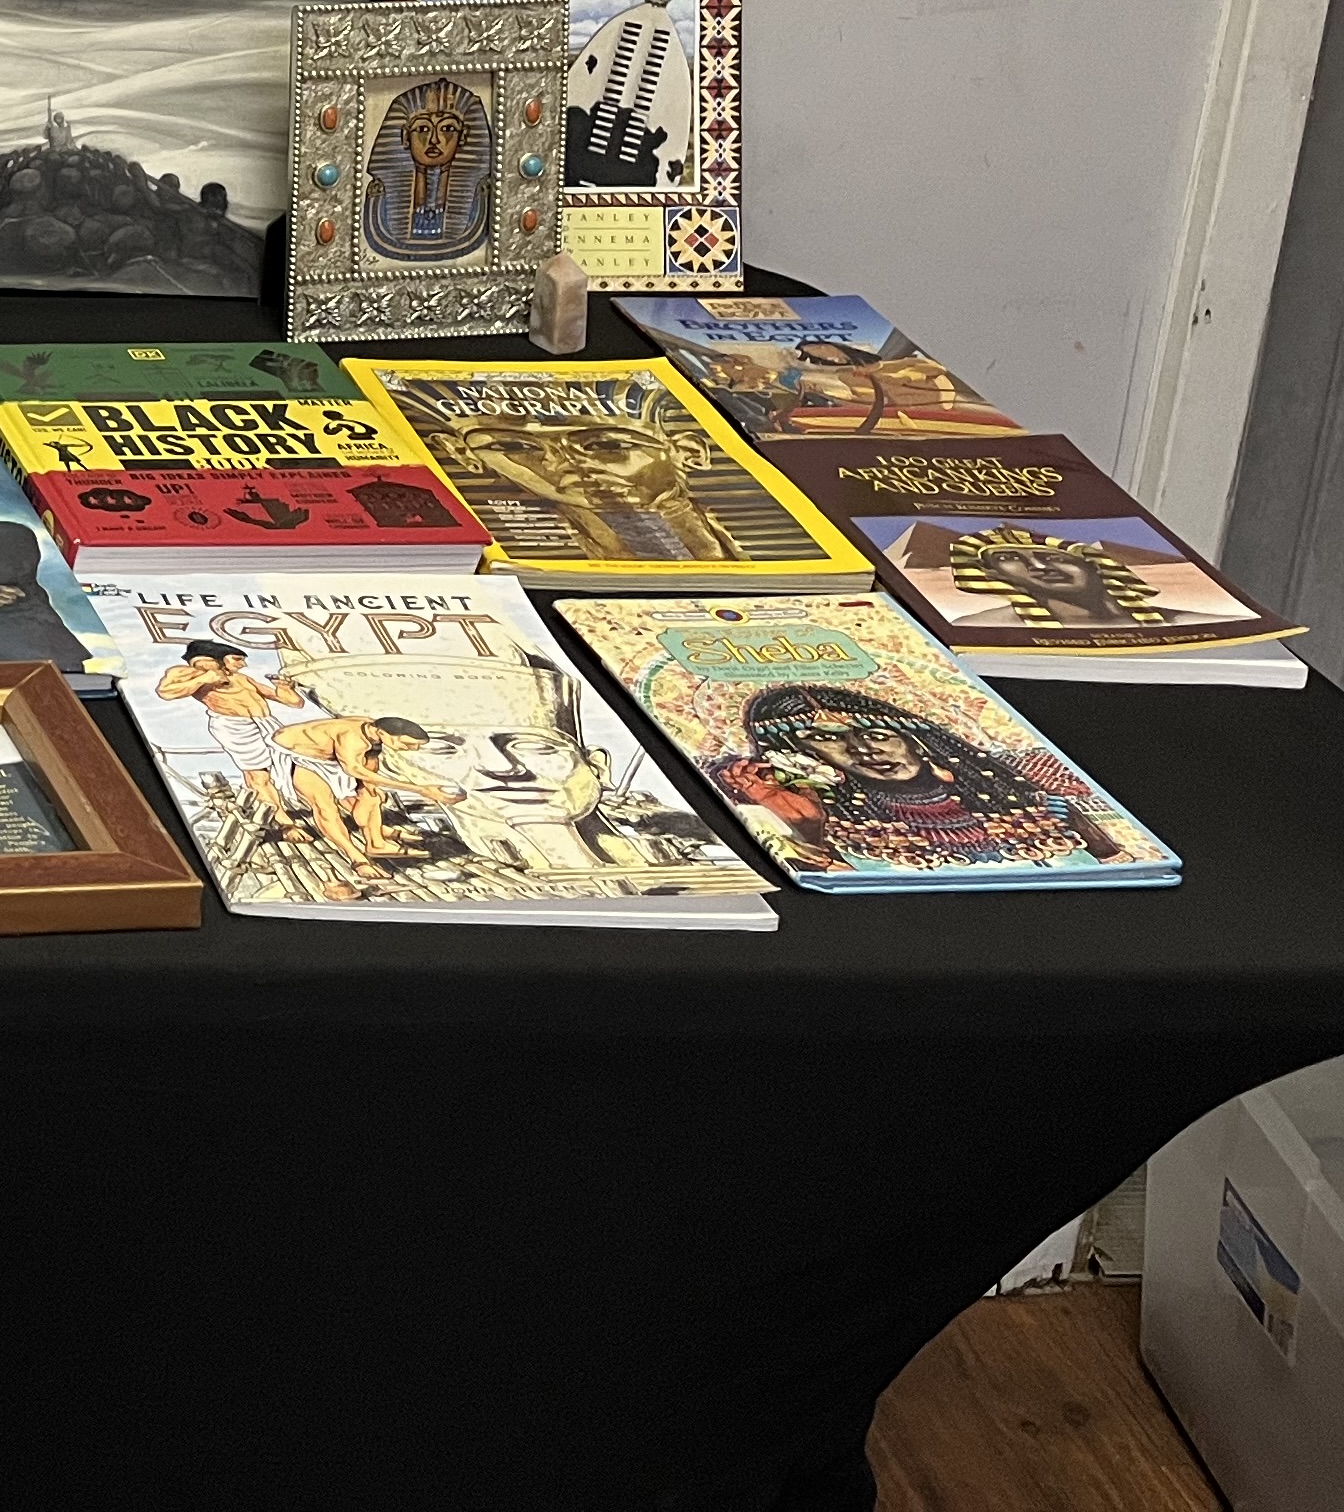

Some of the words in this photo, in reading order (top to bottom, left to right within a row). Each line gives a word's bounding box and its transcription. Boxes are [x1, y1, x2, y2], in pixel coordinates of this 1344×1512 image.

[676, 319, 859, 332] BROTHERS
[705, 332, 738, 341] IN
[742, 331, 855, 343] EGYPT
[132, 349, 161, 360] DK
[456, 385, 607, 400] NATIONAL
[81, 403, 313, 433] BLACK
[296, 399, 354, 407] MATTER
[435, 399, 643, 417] GEOGRAPHIC
[102, 432, 323, 457] HISTORY
[191, 457, 269, 471] BOOK
[337, 442, 388, 451] AFRICA
[344, 454, 401, 462] HUMANITY
[875, 455, 929, 467] 100
[931, 455, 1004, 470] GREAT
[129, 472, 157, 481] BIG
[160, 472, 206, 481] IDEAS
[209, 472, 263, 481] SIMPLY
[268, 470, 353, 481] EXPLAINED
[837, 466, 974, 483] AFRICAN
[972, 466, 1064, 483] KINGS
[873, 479, 940, 495] AND
[941, 481, 1056, 497] QUEENS
[136, 591, 225, 609] LIFE
[244, 593, 283, 610] IN
[303, 593, 473, 612] ANCIENT
[132, 605, 502, 658] EGYPT
[681, 635, 858, 666] Sheba
[343, 670, 442, 680] COLORING
[452, 673, 507, 681] BOOK
